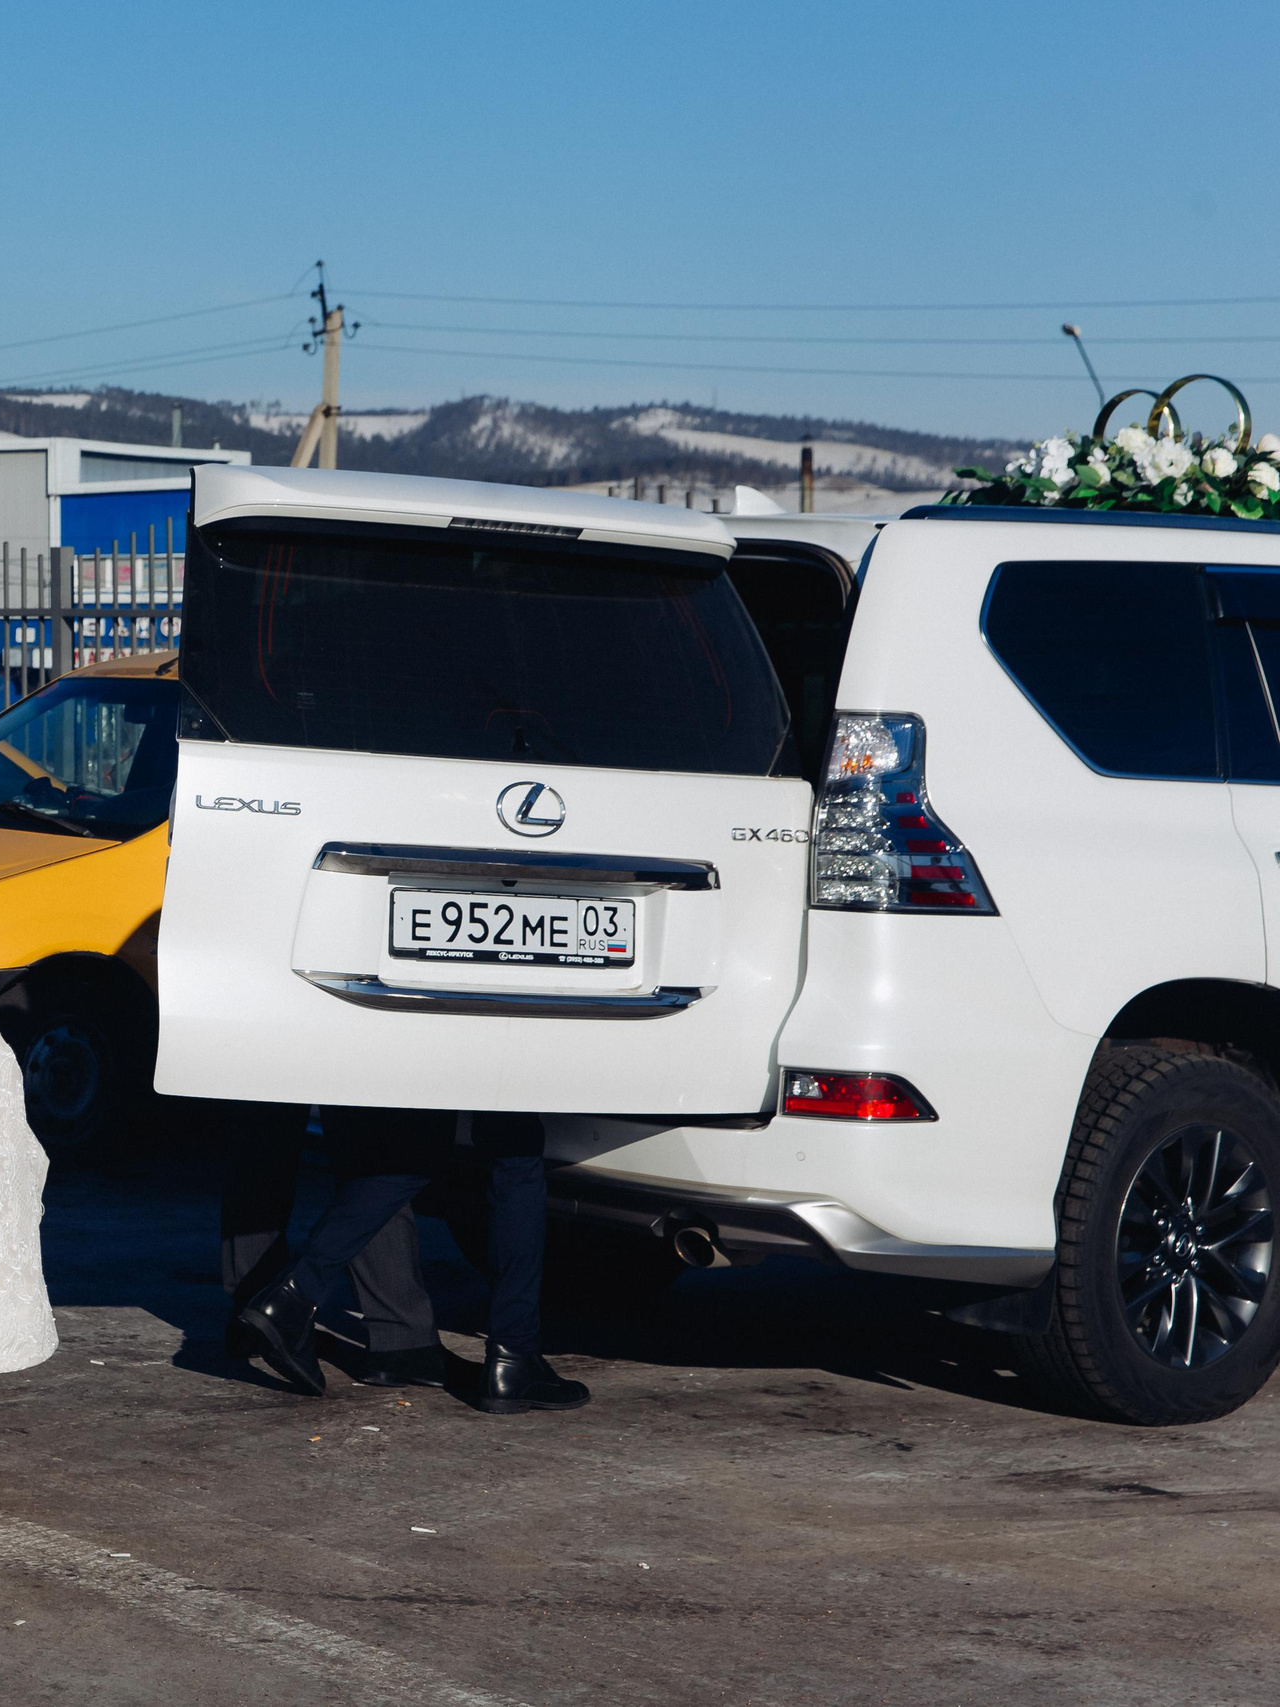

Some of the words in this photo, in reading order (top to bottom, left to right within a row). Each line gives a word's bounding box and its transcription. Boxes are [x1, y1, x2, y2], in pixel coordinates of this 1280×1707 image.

[195, 794, 302, 816] LEXUS
[583, 905, 619, 937] 03
[578, 938, 606, 951] RUS
